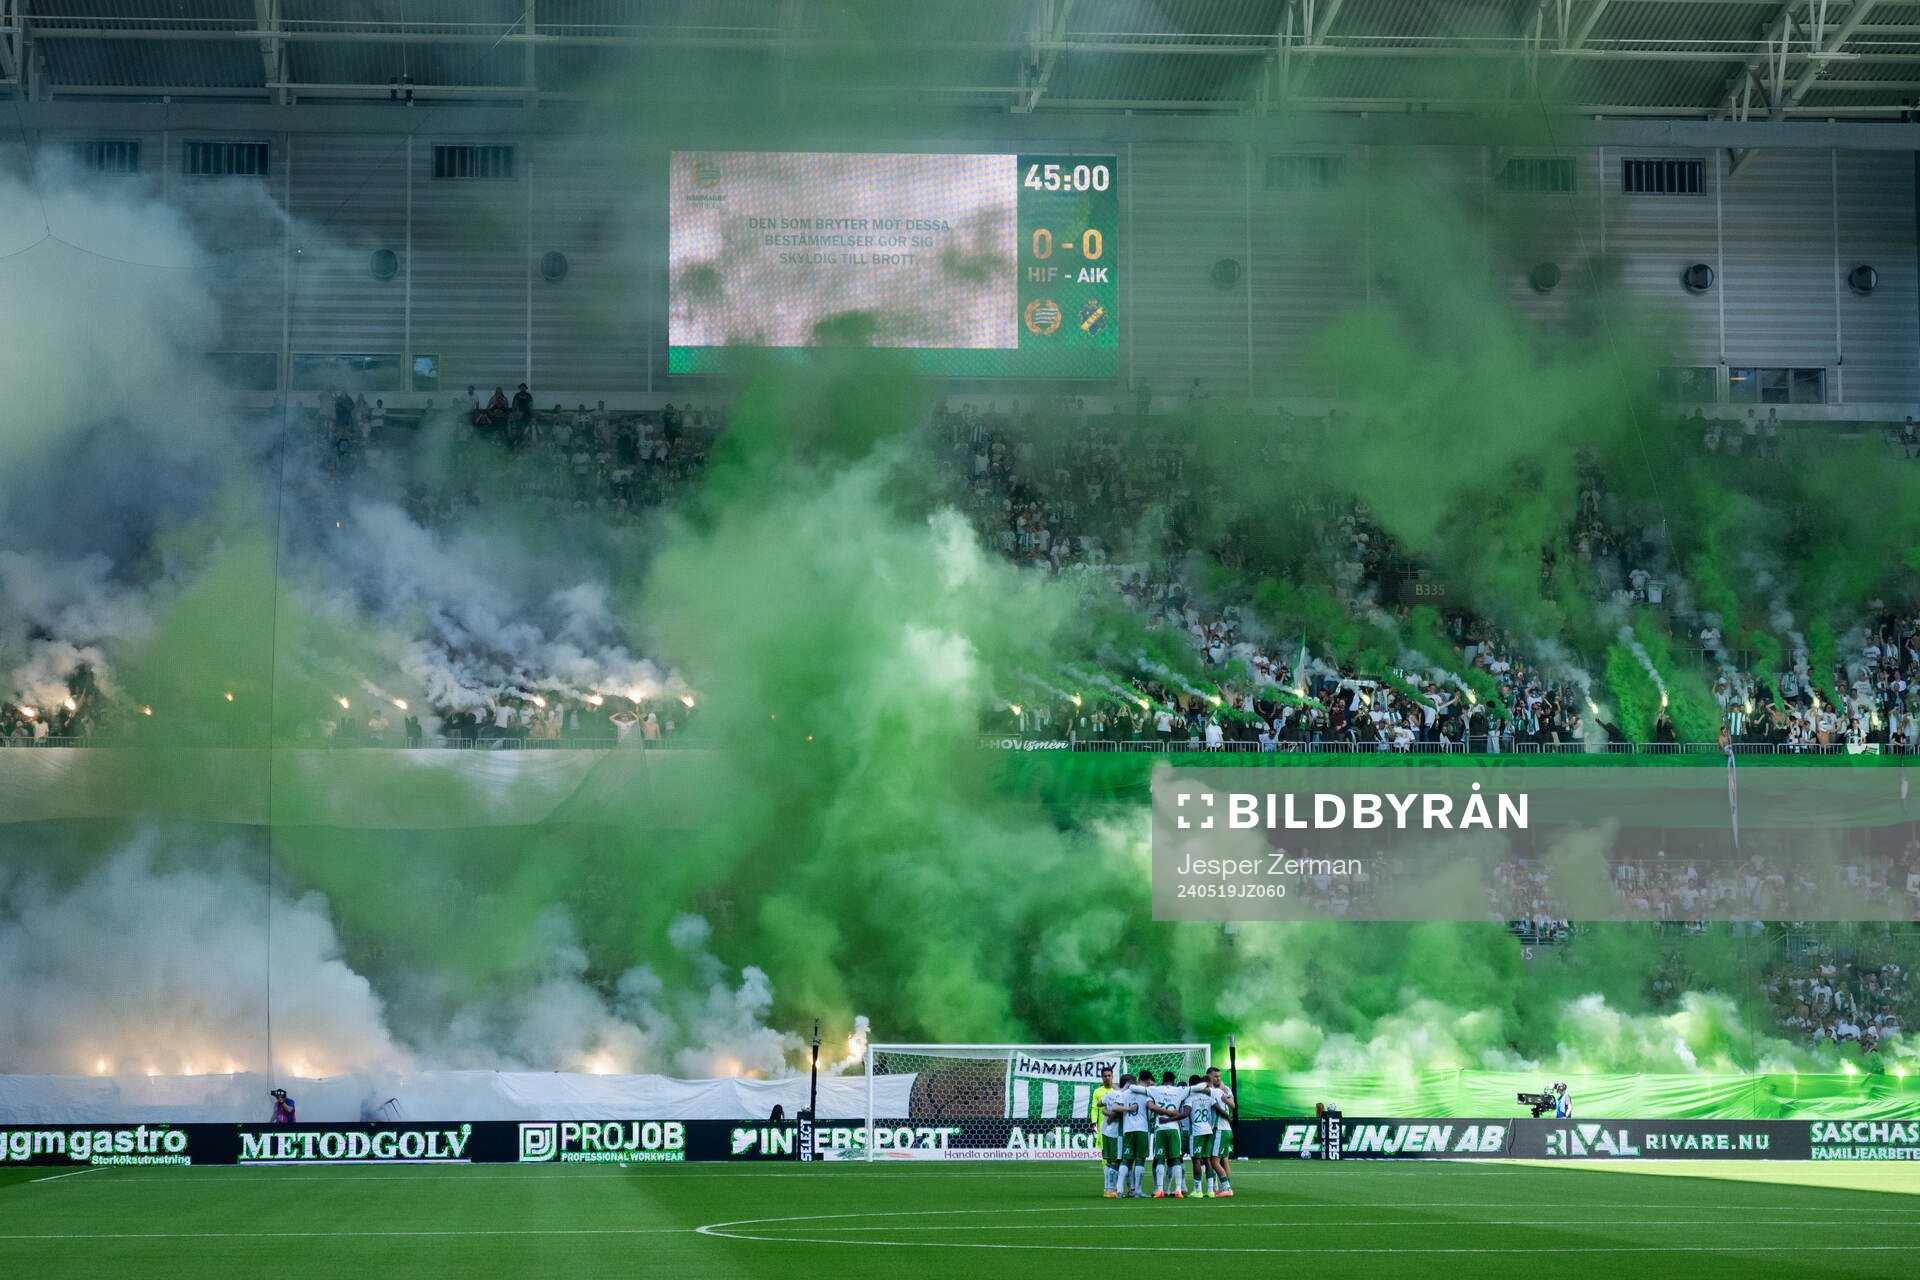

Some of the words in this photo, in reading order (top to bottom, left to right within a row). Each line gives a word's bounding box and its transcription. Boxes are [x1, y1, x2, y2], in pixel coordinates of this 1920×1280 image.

[1023, 164, 1110, 191] 45:00
[749, 217, 776, 230] DEN
[781, 218, 811, 230] SOM
[815, 218, 867, 230] BRYTER
[872, 218, 901, 231] MOT
[905, 219, 951, 231] DESSA
[911, 234, 934, 247] SIG
[1032, 228, 1052, 259] 0
[1082, 228, 1103, 260] 0
[779, 252, 837, 265] SKYLDIG
[842, 253, 867, 265] TILL
[872, 253, 919, 265] BROTT.
[1027, 266, 1058, 282] HIF
[1077, 267, 1109, 283] AIK
[1415, 583, 1446, 596] B335
[1194, 1108, 1209, 1123] 28
[561, 1121, 684, 1150] PROJOB
[760, 1127, 954, 1154] INERSPORT
[801, 1119, 812, 1161] SELECT
[1328, 1117, 1340, 1160] SELECT
[1454, 1125, 1505, 1152] AB
[1546, 1124, 1639, 1155] RIVAL
[1645, 1134, 1770, 1150] RIVARE.NU
[1811, 1122, 1920, 1143] SASCHAS
[240, 1130, 472, 1158] METODGOLV
[561, 1152, 629, 1161] PROFESSIONAL
[631, 1152, 683, 1161] WORKWEAR
[944, 1150, 981, 1159] Handla
[983, 1150, 1014, 1159] online
[1015, 1150, 1029, 1160] på
